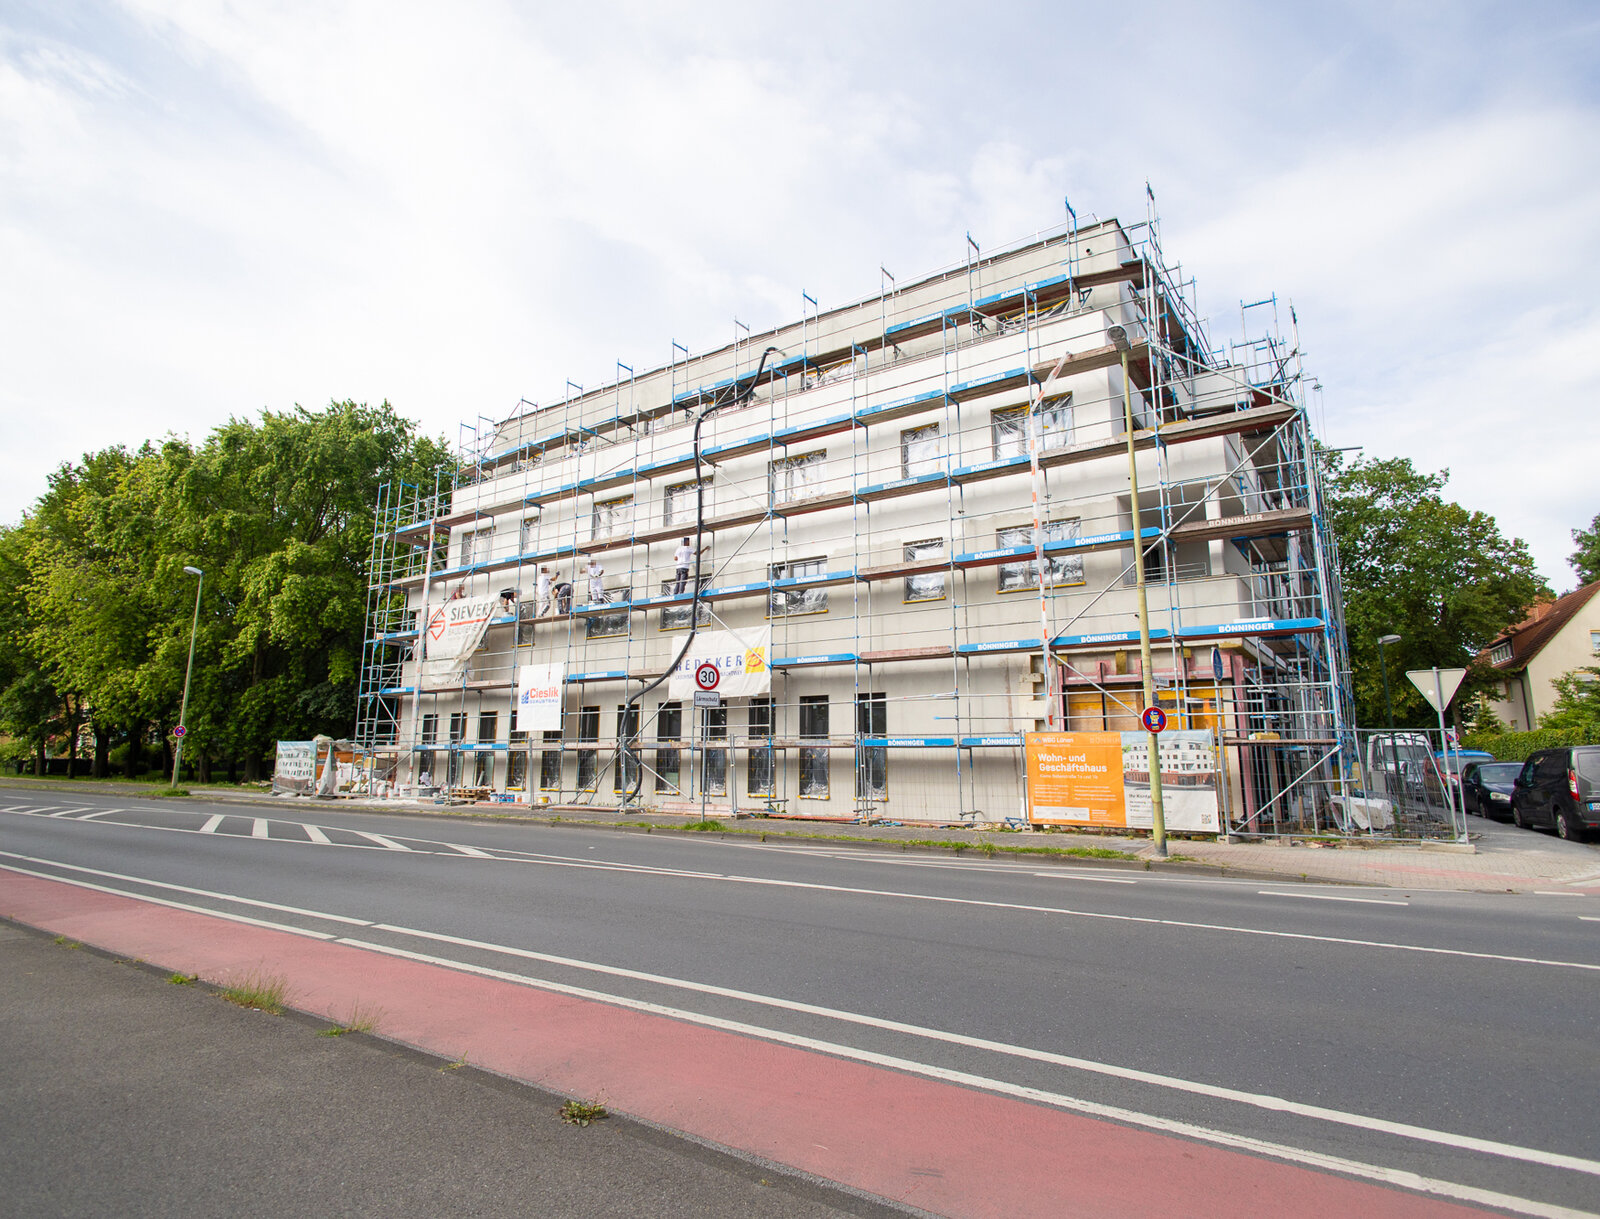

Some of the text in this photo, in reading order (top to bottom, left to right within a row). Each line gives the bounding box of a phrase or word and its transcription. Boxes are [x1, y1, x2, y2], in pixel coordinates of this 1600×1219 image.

[1075, 533, 1122, 545] BÖNNINGER
[974, 549, 1015, 560] BÖNNINGER
[1218, 622, 1275, 633] BÖNNINGER
[1080, 633, 1128, 643] BÖNNINGER
[977, 641, 1019, 650] BÖNNINGER
[701, 671, 715, 683] 30
[530, 687, 559, 698] Cieslik
[1038, 753, 1086, 762] Wohn- und
[1039, 763, 1107, 773] Geschäftshaus
